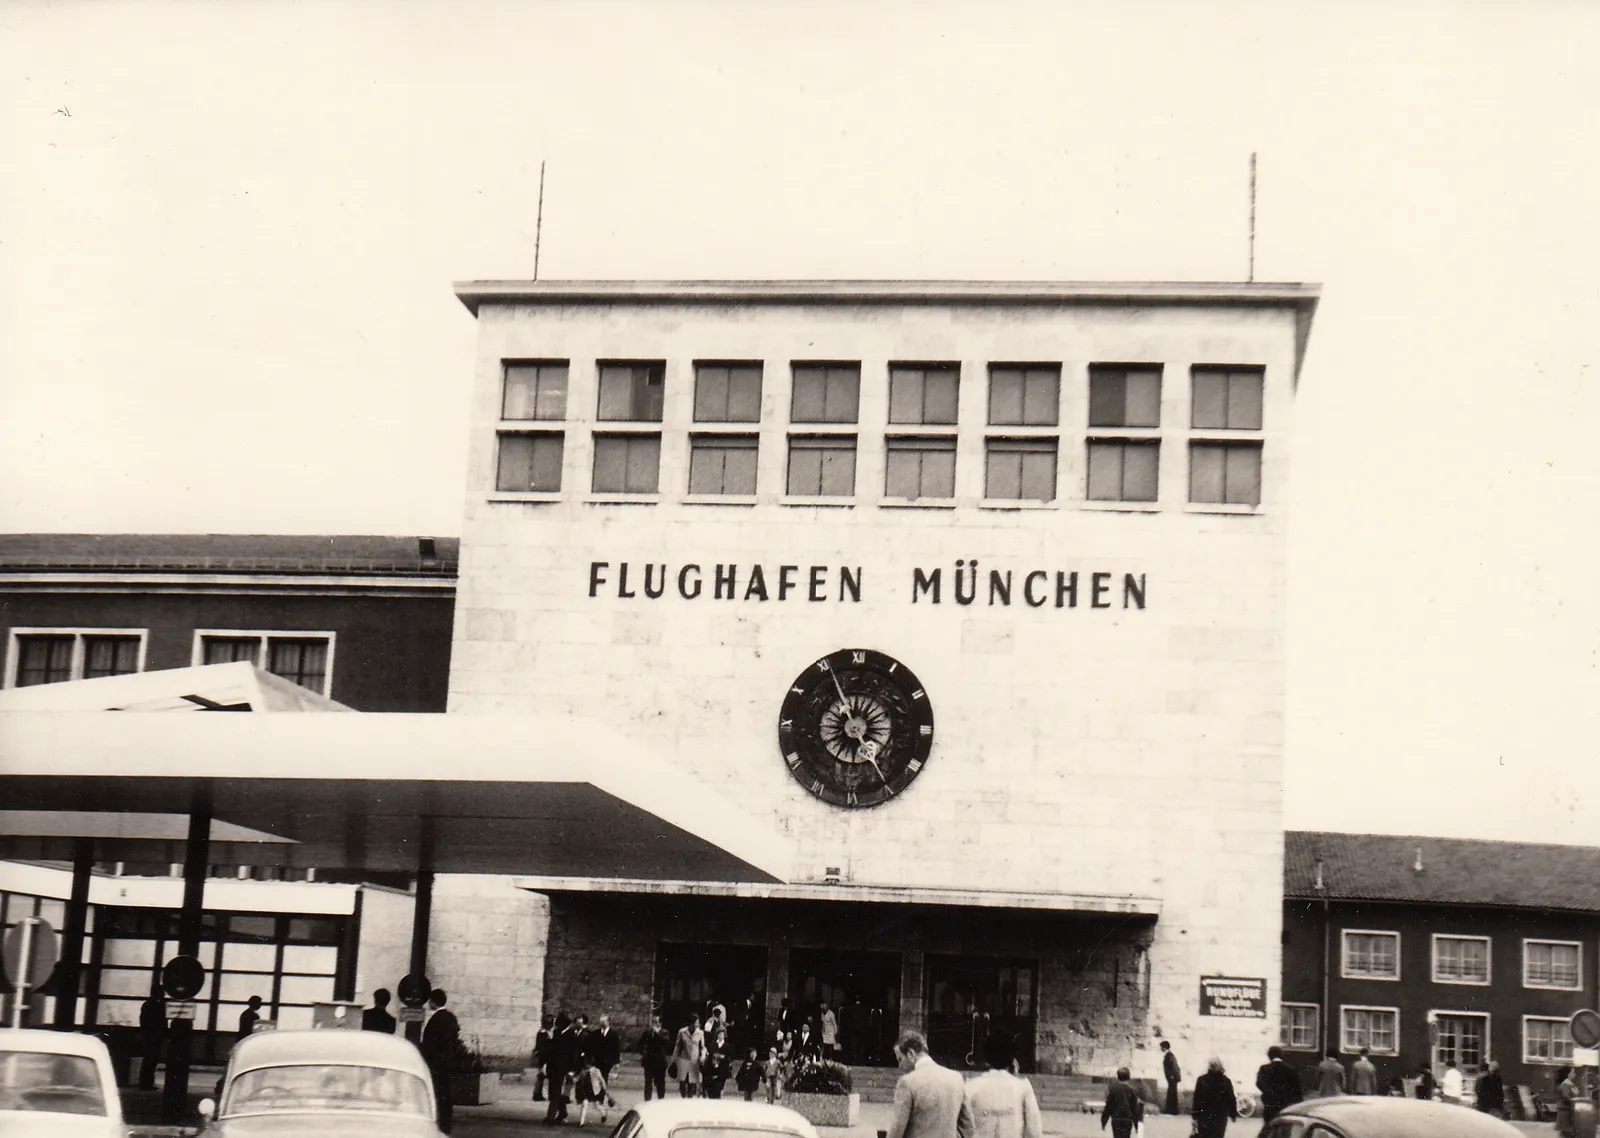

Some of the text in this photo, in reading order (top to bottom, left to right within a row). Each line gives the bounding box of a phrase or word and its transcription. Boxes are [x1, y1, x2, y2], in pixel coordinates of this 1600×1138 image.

[589, 559, 1146, 609] FLUGHAFEN MÜNCHEN
[852, 651, 866, 664] XII
[816, 658, 829, 672] XI
[889, 662, 897, 672] I
[791, 685, 804, 695] X
[912, 689, 924, 700] II
[920, 725, 932, 735] III
